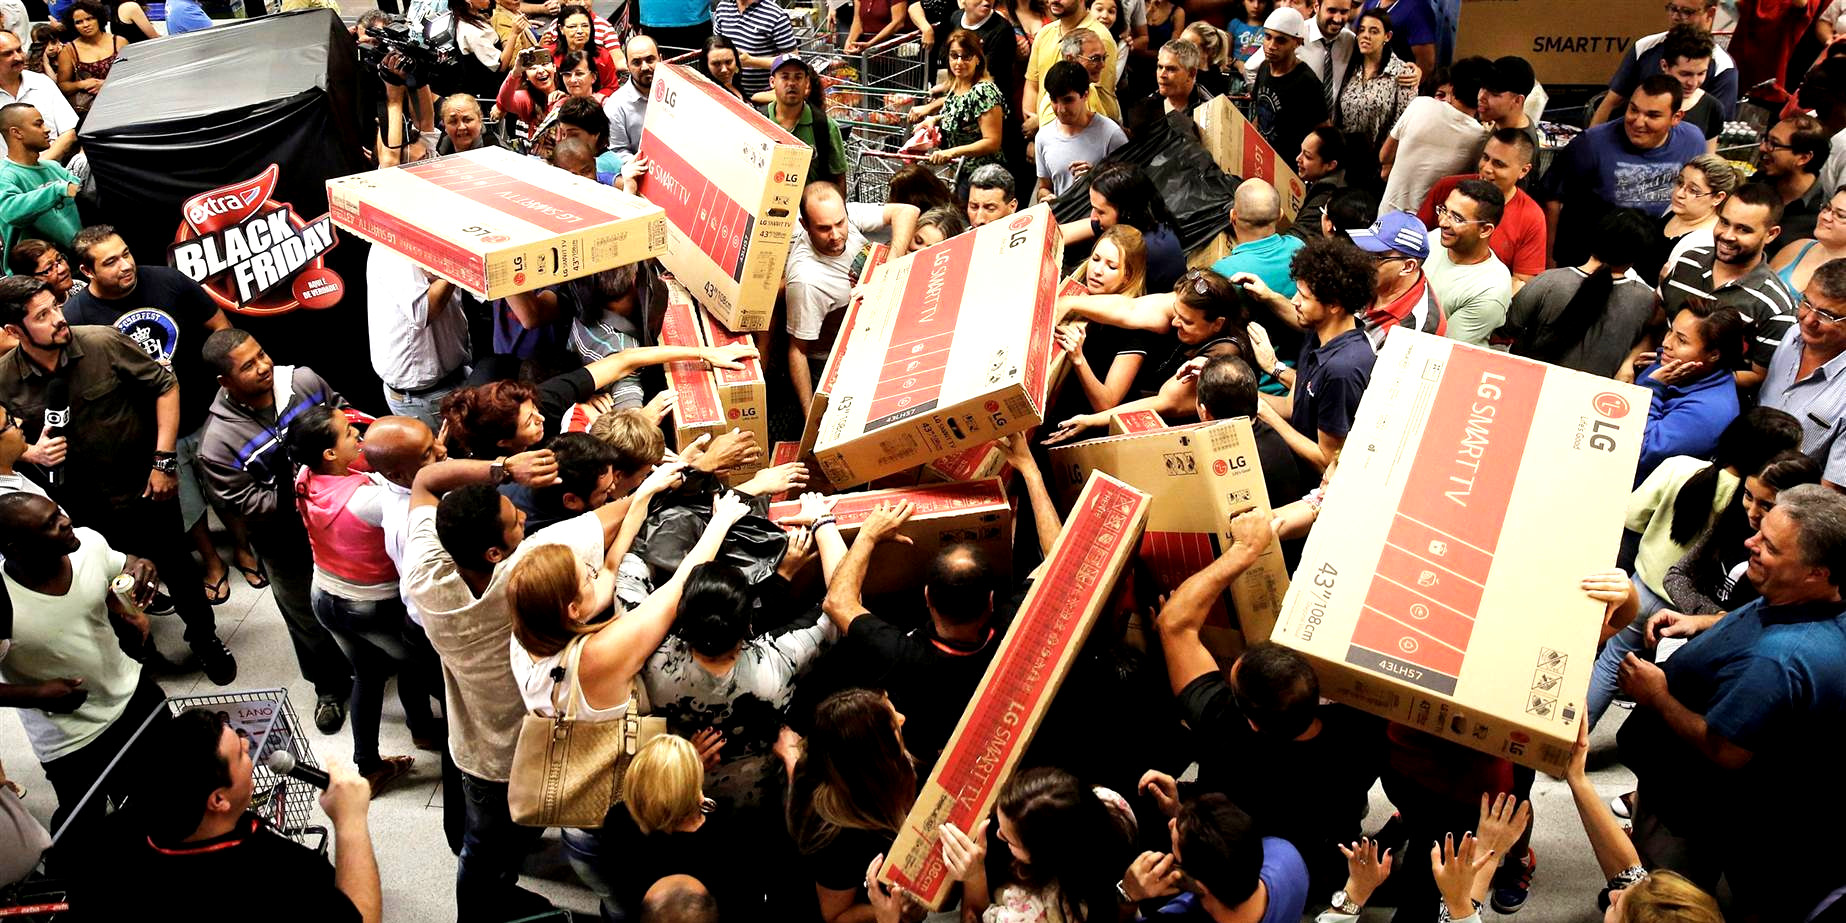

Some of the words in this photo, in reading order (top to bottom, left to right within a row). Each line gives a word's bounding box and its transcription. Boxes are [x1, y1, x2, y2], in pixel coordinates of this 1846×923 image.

[1533, 36, 1602, 53] SMART
[1604, 36, 1631, 53] TV
[665, 88, 677, 108] LG
[654, 163, 679, 197] SMART
[678, 186, 691, 206] TV
[786, 174, 798, 183] LG
[189, 194, 243, 225] extra
[1291, 195, 1301, 213] LG
[462, 226, 491, 237] LG
[1010, 229, 1028, 248] LG
[175, 208, 296, 283] BLACK
[234, 217, 333, 303] FRIDAY
[514, 256, 523, 272] LG
[934, 248, 951, 266] LG
[303, 290, 312, 300] DE
[924, 266, 947, 304] SMART
[918, 302, 939, 324] TV
[1477, 371, 1506, 401] LG
[742, 408, 756, 417] LG
[933, 415, 941, 425] LG
[992, 412, 1007, 428] LG
[1455, 402, 1496, 473] SMART
[1590, 419, 1621, 453] LG
[1068, 463, 1083, 484] LG
[1229, 456, 1246, 470] LG
[1444, 476, 1475, 507] TV
[1302, 562, 1338, 642] 43"/108cm
[1378, 659, 1423, 681] 43LH57
[1003, 701, 1025, 726] LG
[971, 726, 1012, 784] SMART
[1509, 741, 1524, 756] LG
[956, 784, 983, 811] TV
